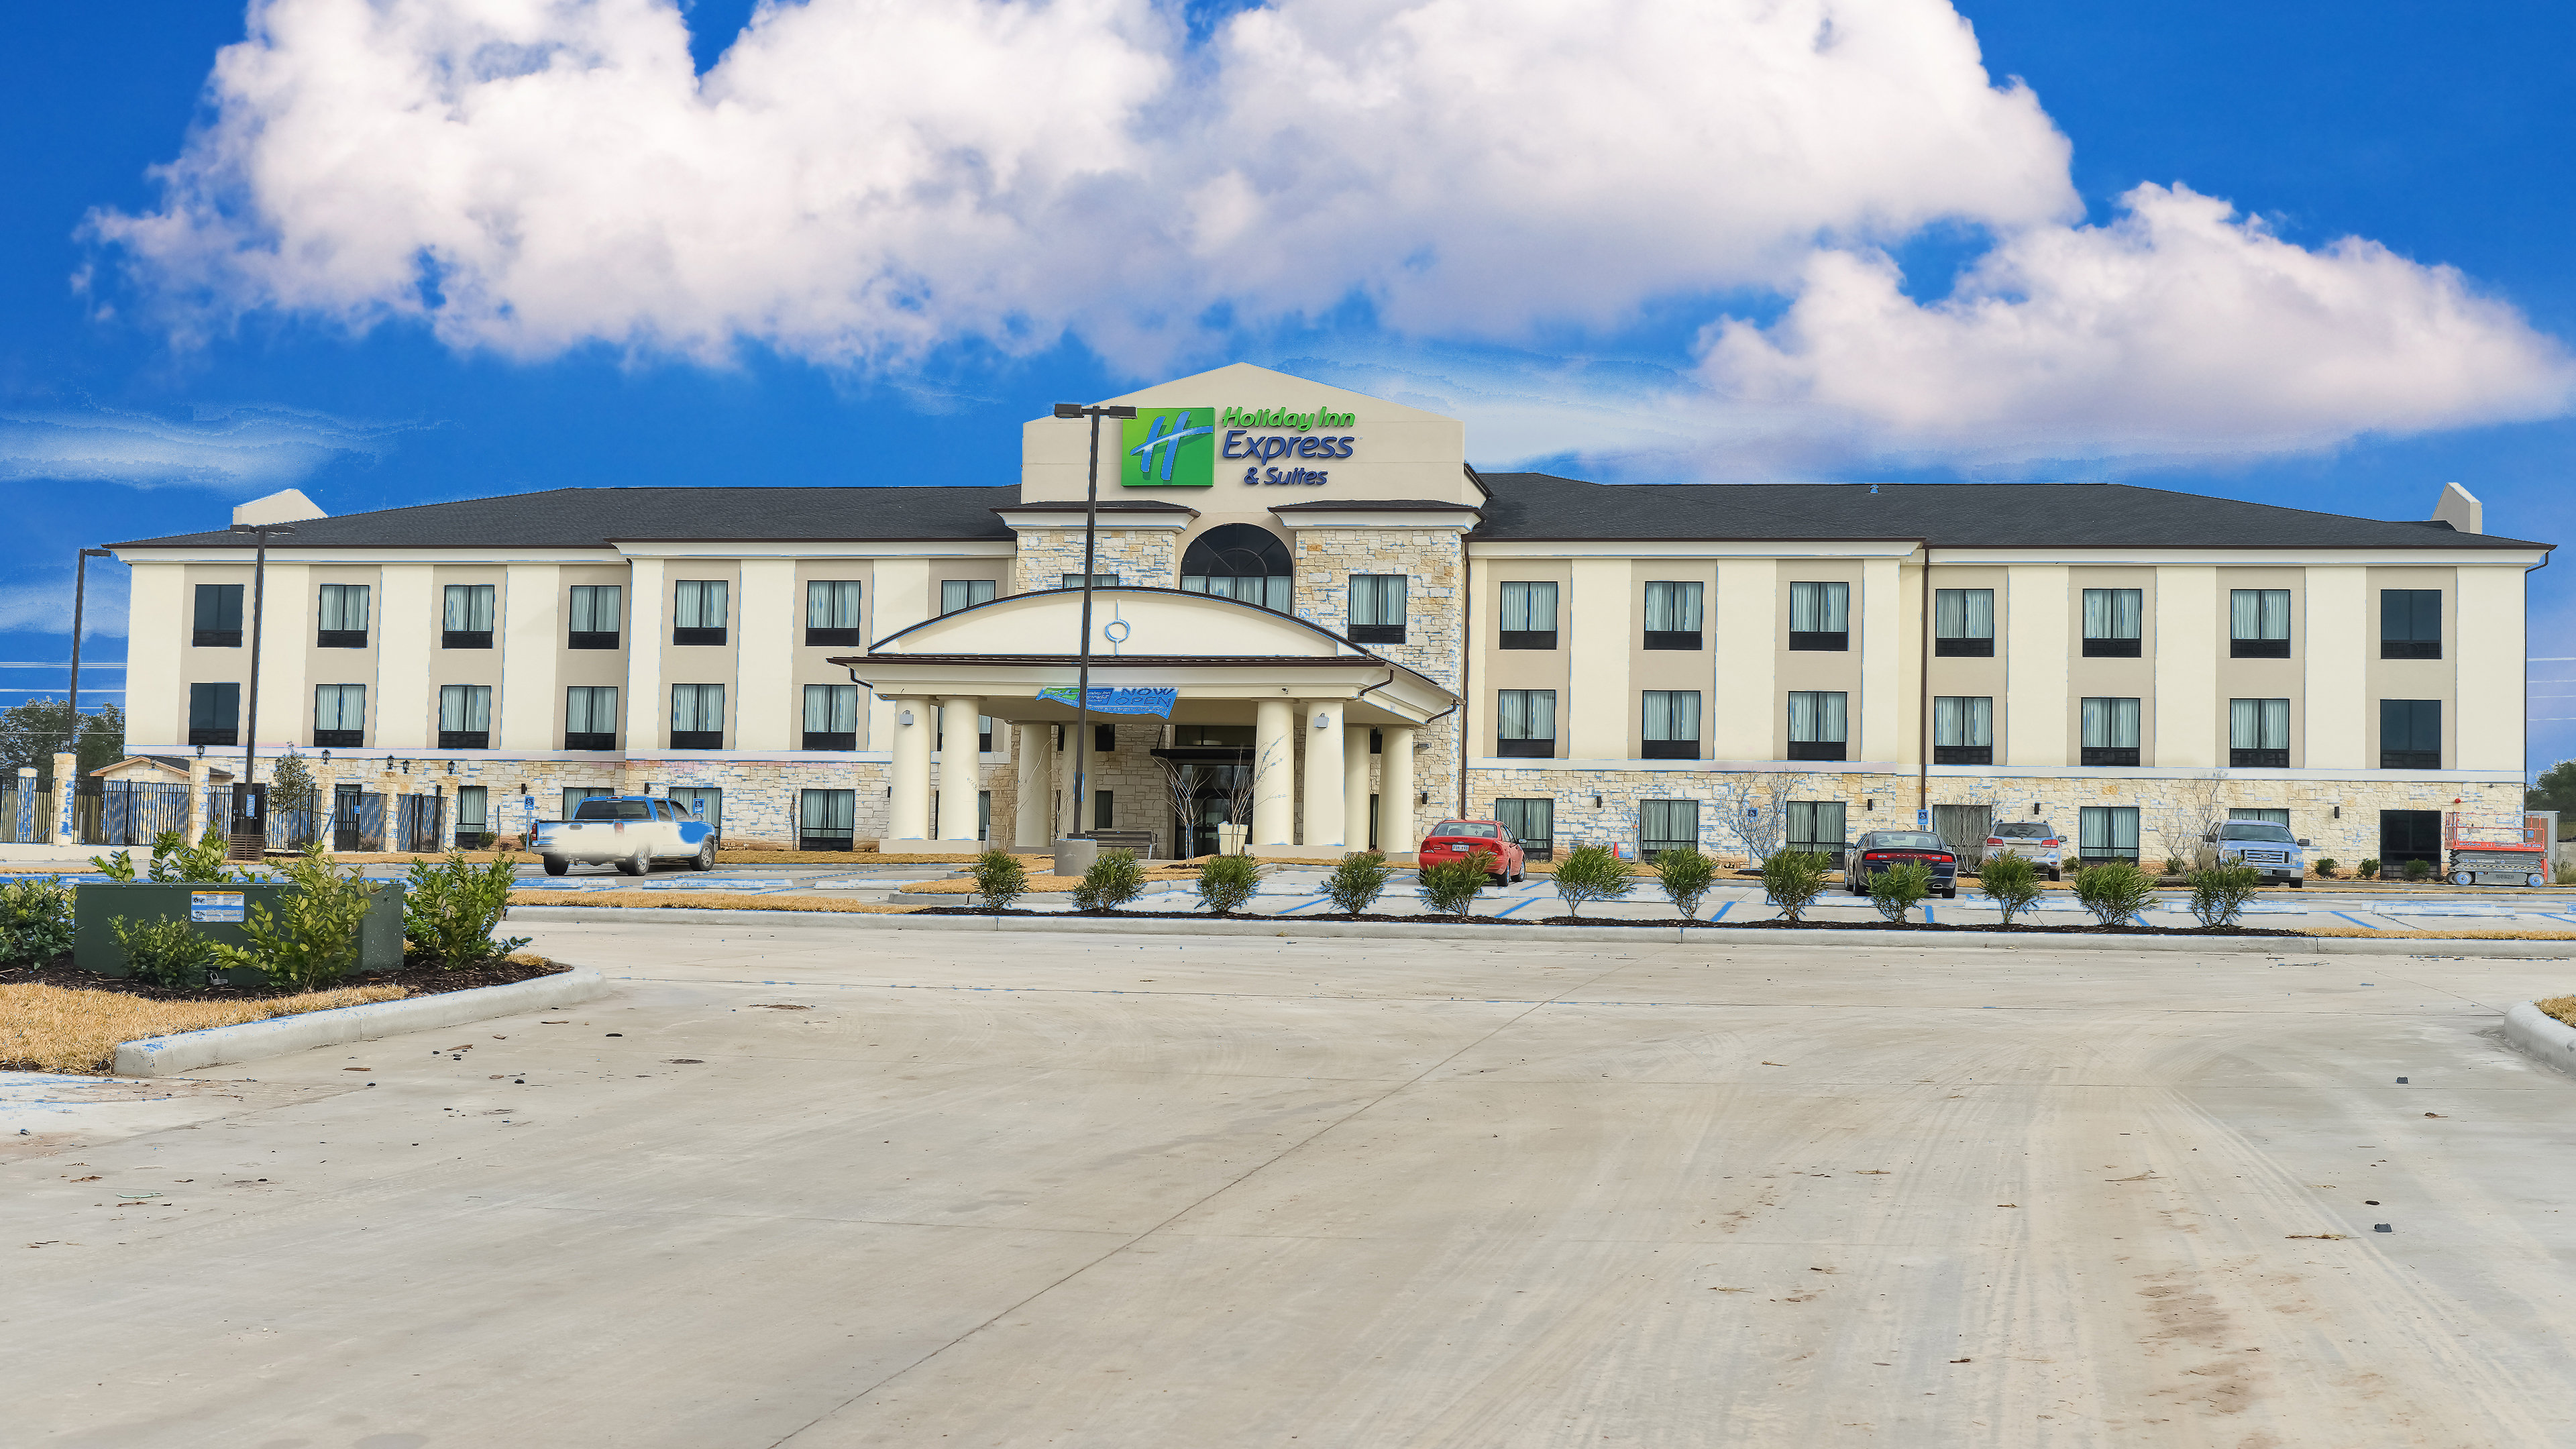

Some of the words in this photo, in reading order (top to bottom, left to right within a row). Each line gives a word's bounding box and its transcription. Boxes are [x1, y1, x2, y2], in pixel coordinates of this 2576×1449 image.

[1222, 406, 1315, 431] Holiday
[1318, 406, 1356, 427] Inn
[1222, 429, 1356, 466] Express
[1244, 466, 1260, 485] &
[1264, 466, 1328, 485] Suites
[1120, 688, 1175, 696] NOW
[1115, 696, 1172, 708] OPEN
